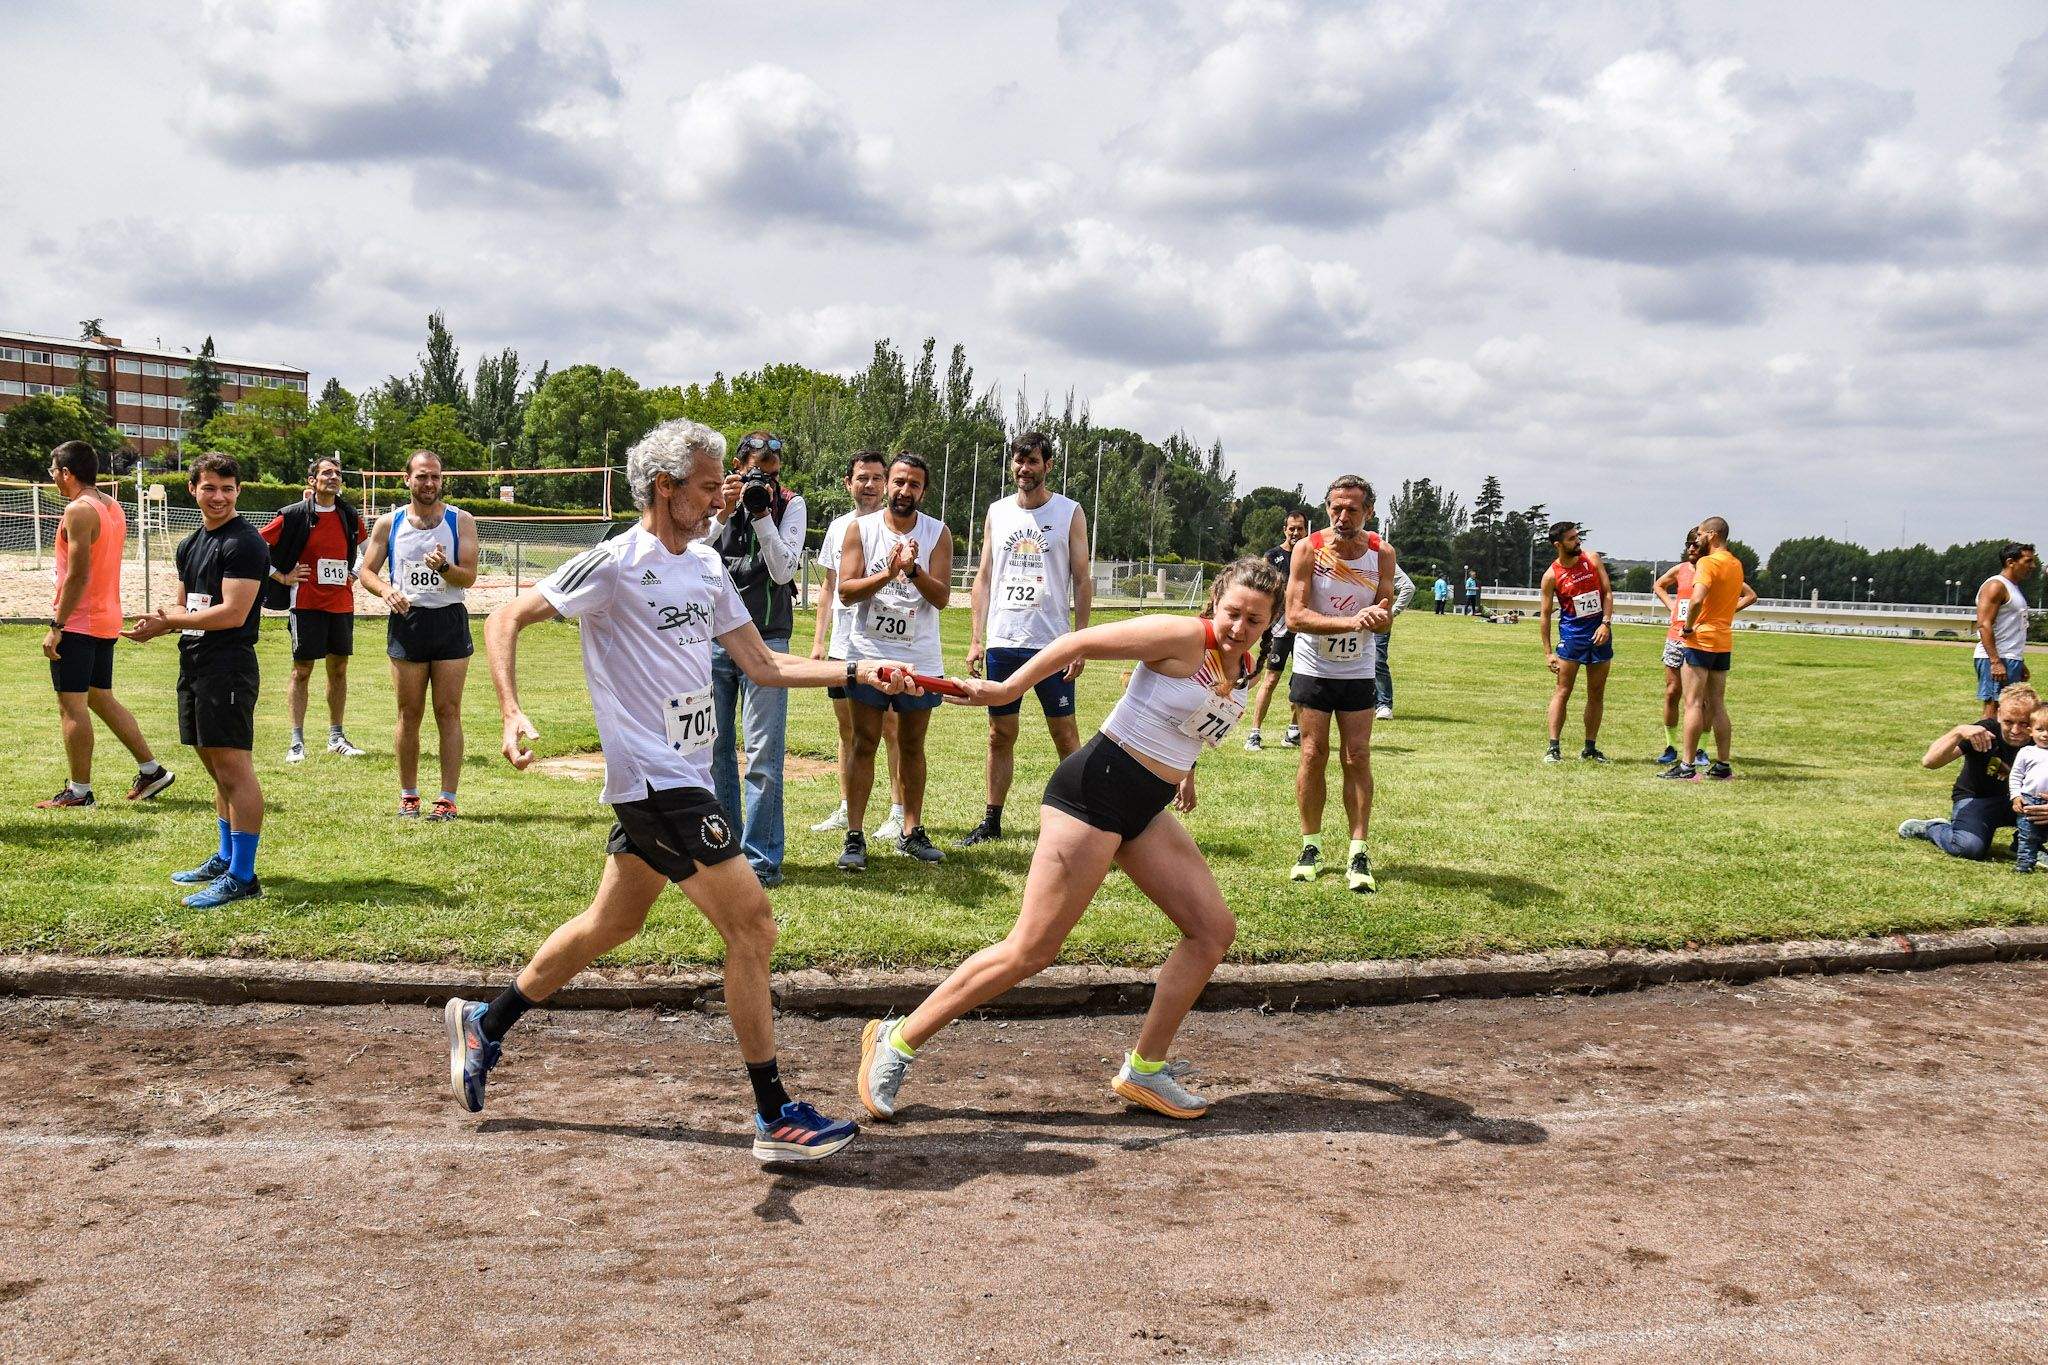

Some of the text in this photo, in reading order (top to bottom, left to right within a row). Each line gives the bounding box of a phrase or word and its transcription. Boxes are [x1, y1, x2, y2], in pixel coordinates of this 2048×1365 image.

[1003, 529, 1050, 553] SANTA MONICA
[324, 567, 344, 579] 818
[411, 572, 440, 586] 886
[1006, 586, 1035, 601] 732
[1579, 598, 1598, 611] 743
[875, 615, 907, 635] 730
[1327, 637, 1357, 653] 715
[679, 705, 712, 740] 707
[1197, 712, 1231, 742] 774
